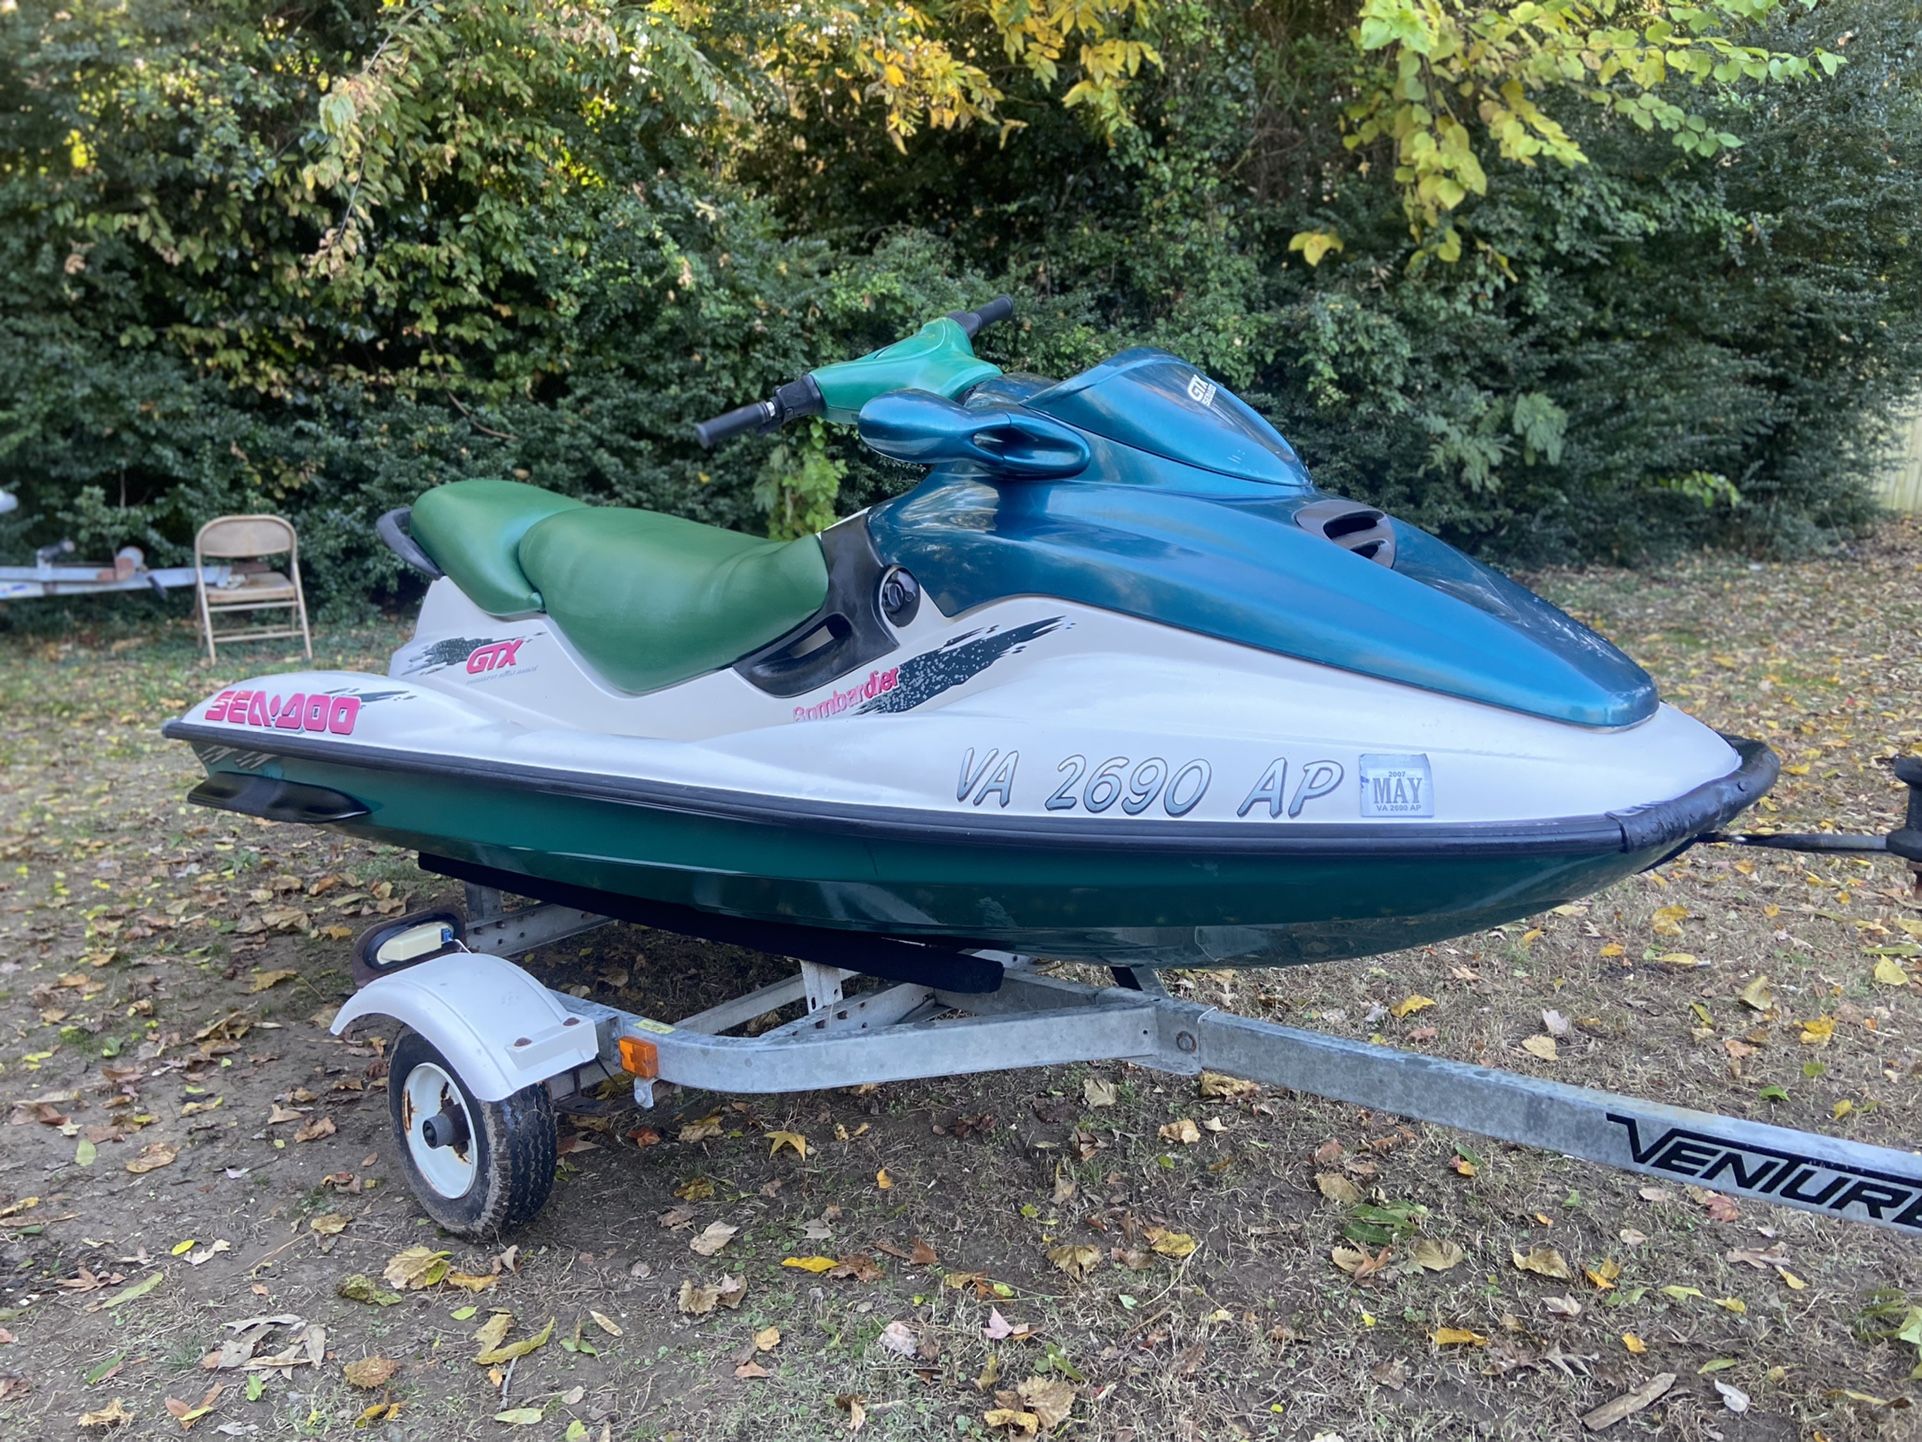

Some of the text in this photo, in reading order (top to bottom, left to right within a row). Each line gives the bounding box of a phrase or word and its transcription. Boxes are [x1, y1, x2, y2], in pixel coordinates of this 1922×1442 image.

[465, 637, 524, 675] GTX
[955, 747, 1345, 819] VA 2690 AP
[1372, 777, 1423, 804] MAY
